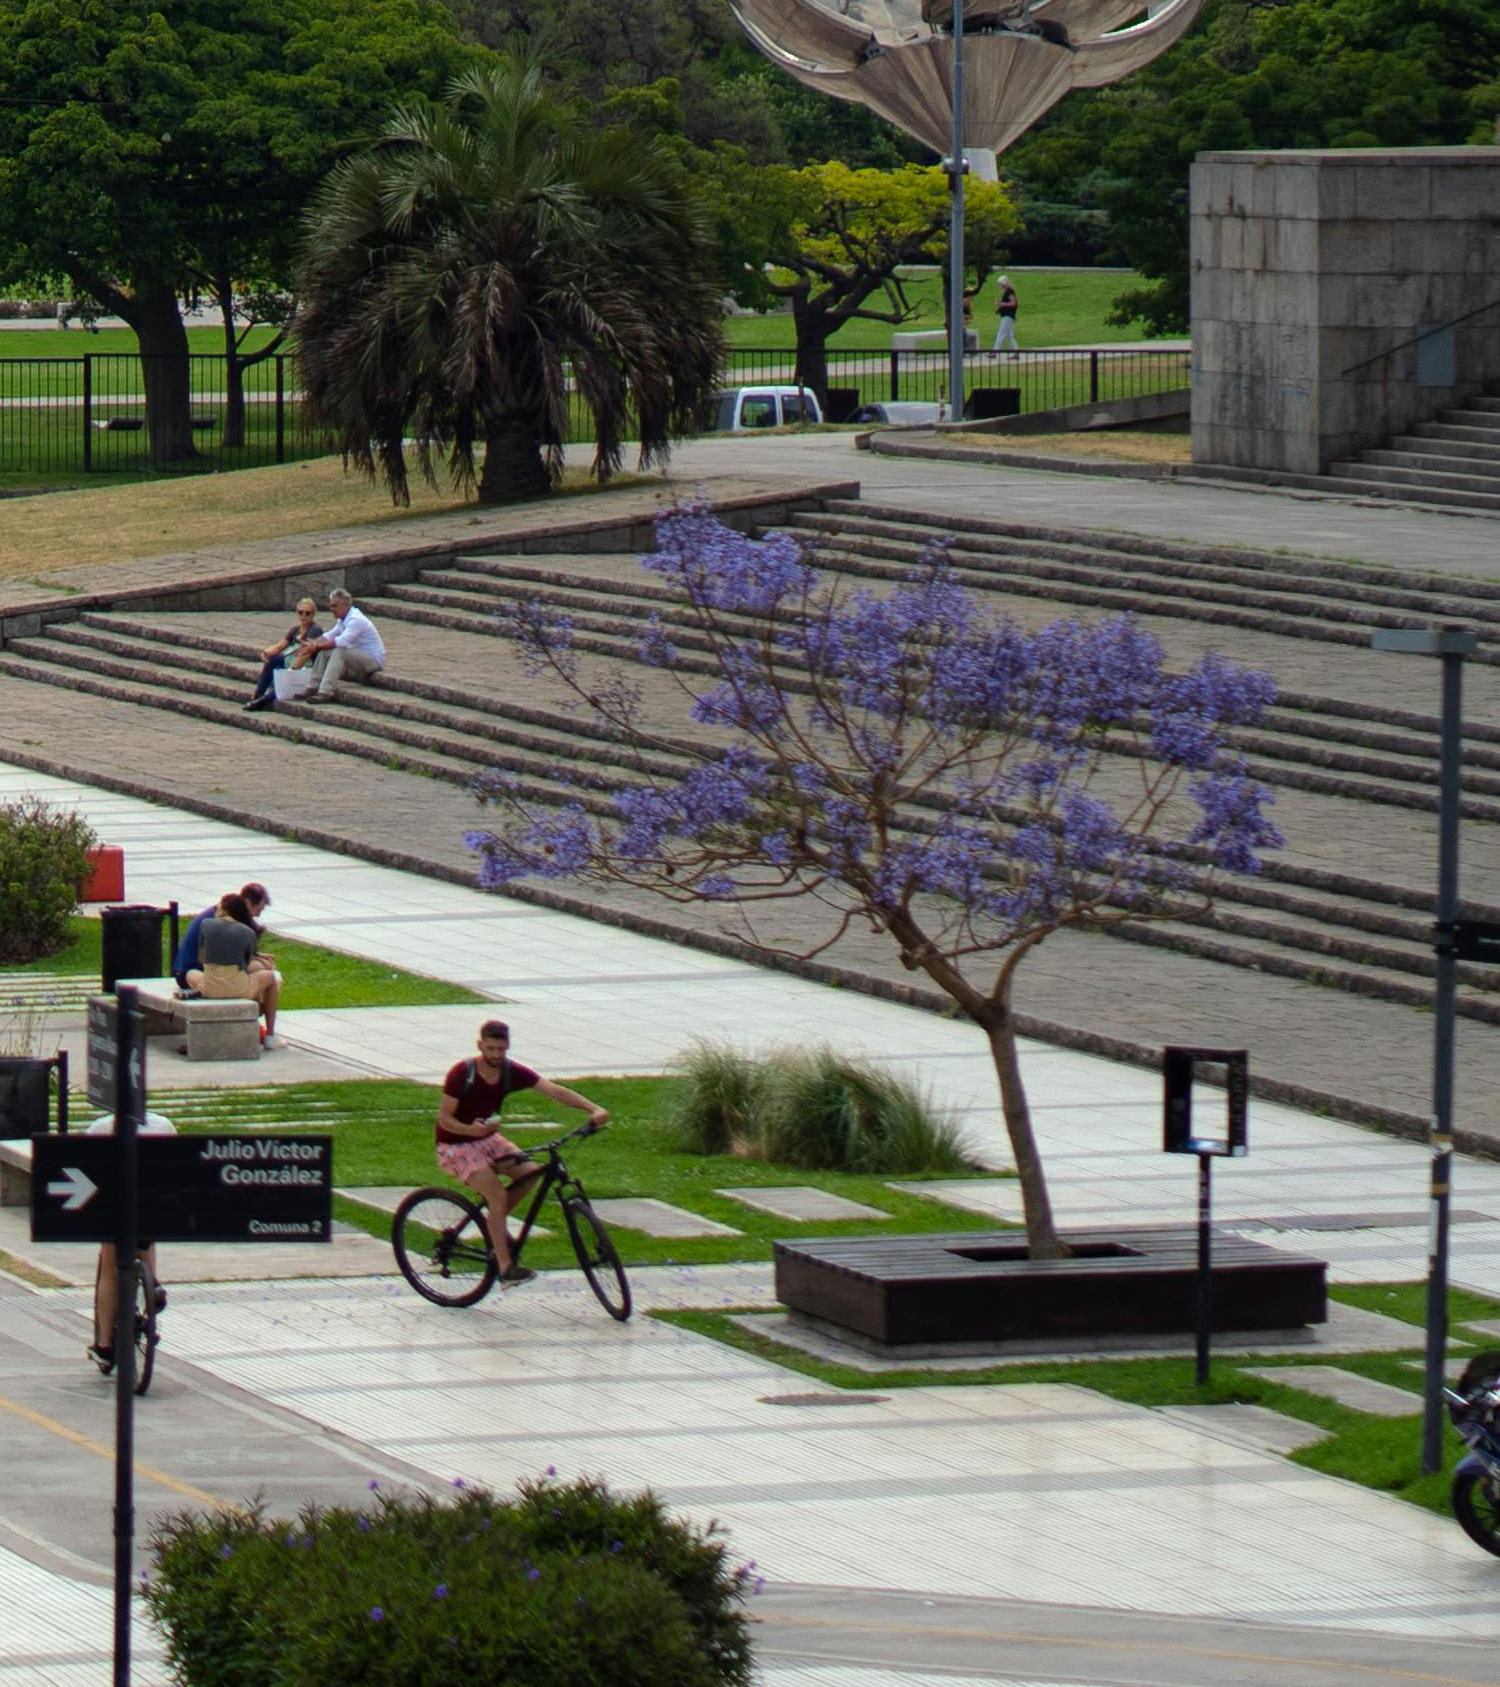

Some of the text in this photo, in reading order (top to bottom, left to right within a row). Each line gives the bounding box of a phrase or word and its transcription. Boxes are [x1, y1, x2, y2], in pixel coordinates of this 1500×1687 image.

[200, 1139, 255, 1160] Julio
[221, 1164, 324, 1185] González
[248, 1219, 323, 1234] Comuna 2
